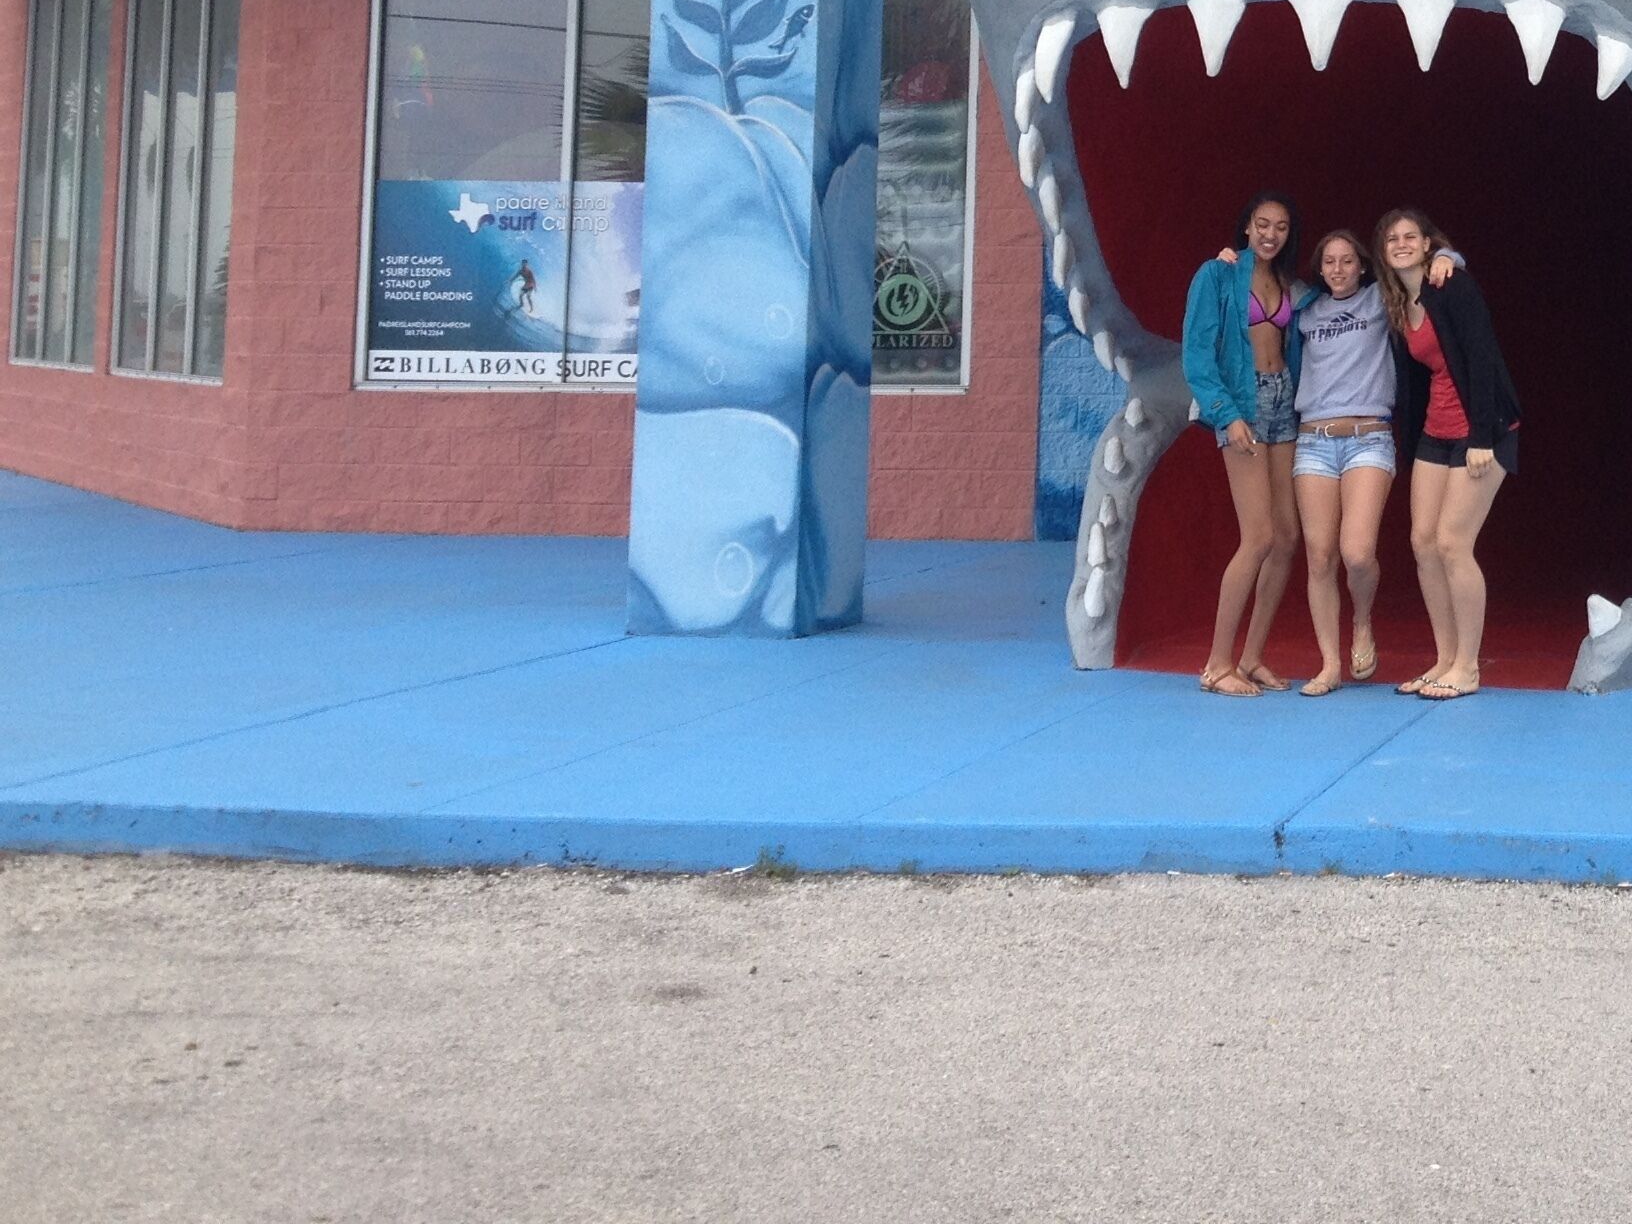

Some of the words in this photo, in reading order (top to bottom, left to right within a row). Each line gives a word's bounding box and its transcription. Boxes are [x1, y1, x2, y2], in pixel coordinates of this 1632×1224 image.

[496, 195, 550, 213] padre
[498, 212, 538, 231] surf
[542, 214, 610, 235] camp
[385, 255, 409, 265] SURF
[410, 256, 444, 266] CAMPS
[385, 267, 409, 277] SURF
[410, 268, 452, 278] LESSONS
[385, 279, 417, 289] STAND
[418, 279, 431, 289] UP
[384, 291, 421, 301] PADDLE
[422, 291, 473, 302] BOARDING
[1317, 320, 1368, 343] PATRIOTS
[556, 359, 613, 377] SURF
